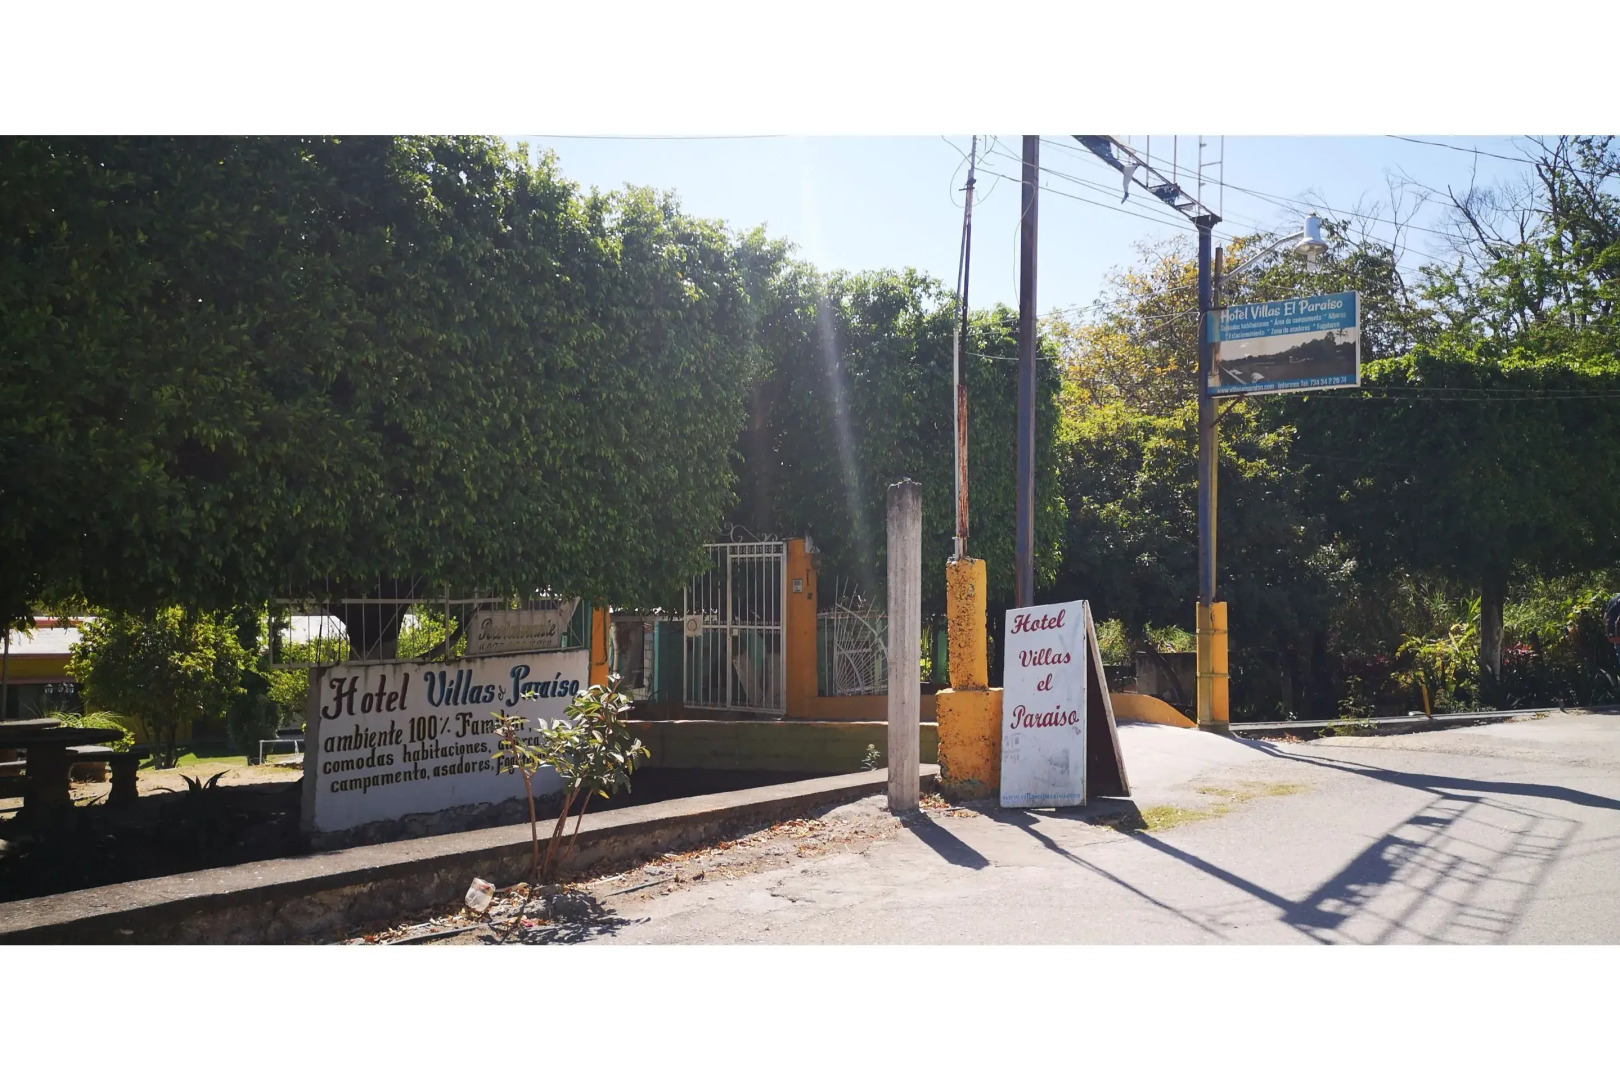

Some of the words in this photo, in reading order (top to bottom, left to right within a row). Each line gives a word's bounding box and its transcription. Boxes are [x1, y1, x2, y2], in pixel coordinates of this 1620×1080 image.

[1221, 306, 1248, 323] Hotel
[1251, 304, 1280, 320] Villas
[1284, 301, 1296, 316] El
[1010, 609, 1066, 634] Hotel
[1019, 648, 1071, 668] Villas
[321, 672, 410, 720] Hotel
[424, 669, 496, 707] Villas
[1037, 673, 1053, 692] el
[323, 720, 403, 753] ambiente
[409, 715, 451, 743] 100%
[455, 709, 532, 738] Famlar,
[323, 747, 394, 774] comodas
[403, 739, 492, 764] habitaciones,
[330, 762, 430, 794] campamento,
[433, 753, 494, 777] asadores,
